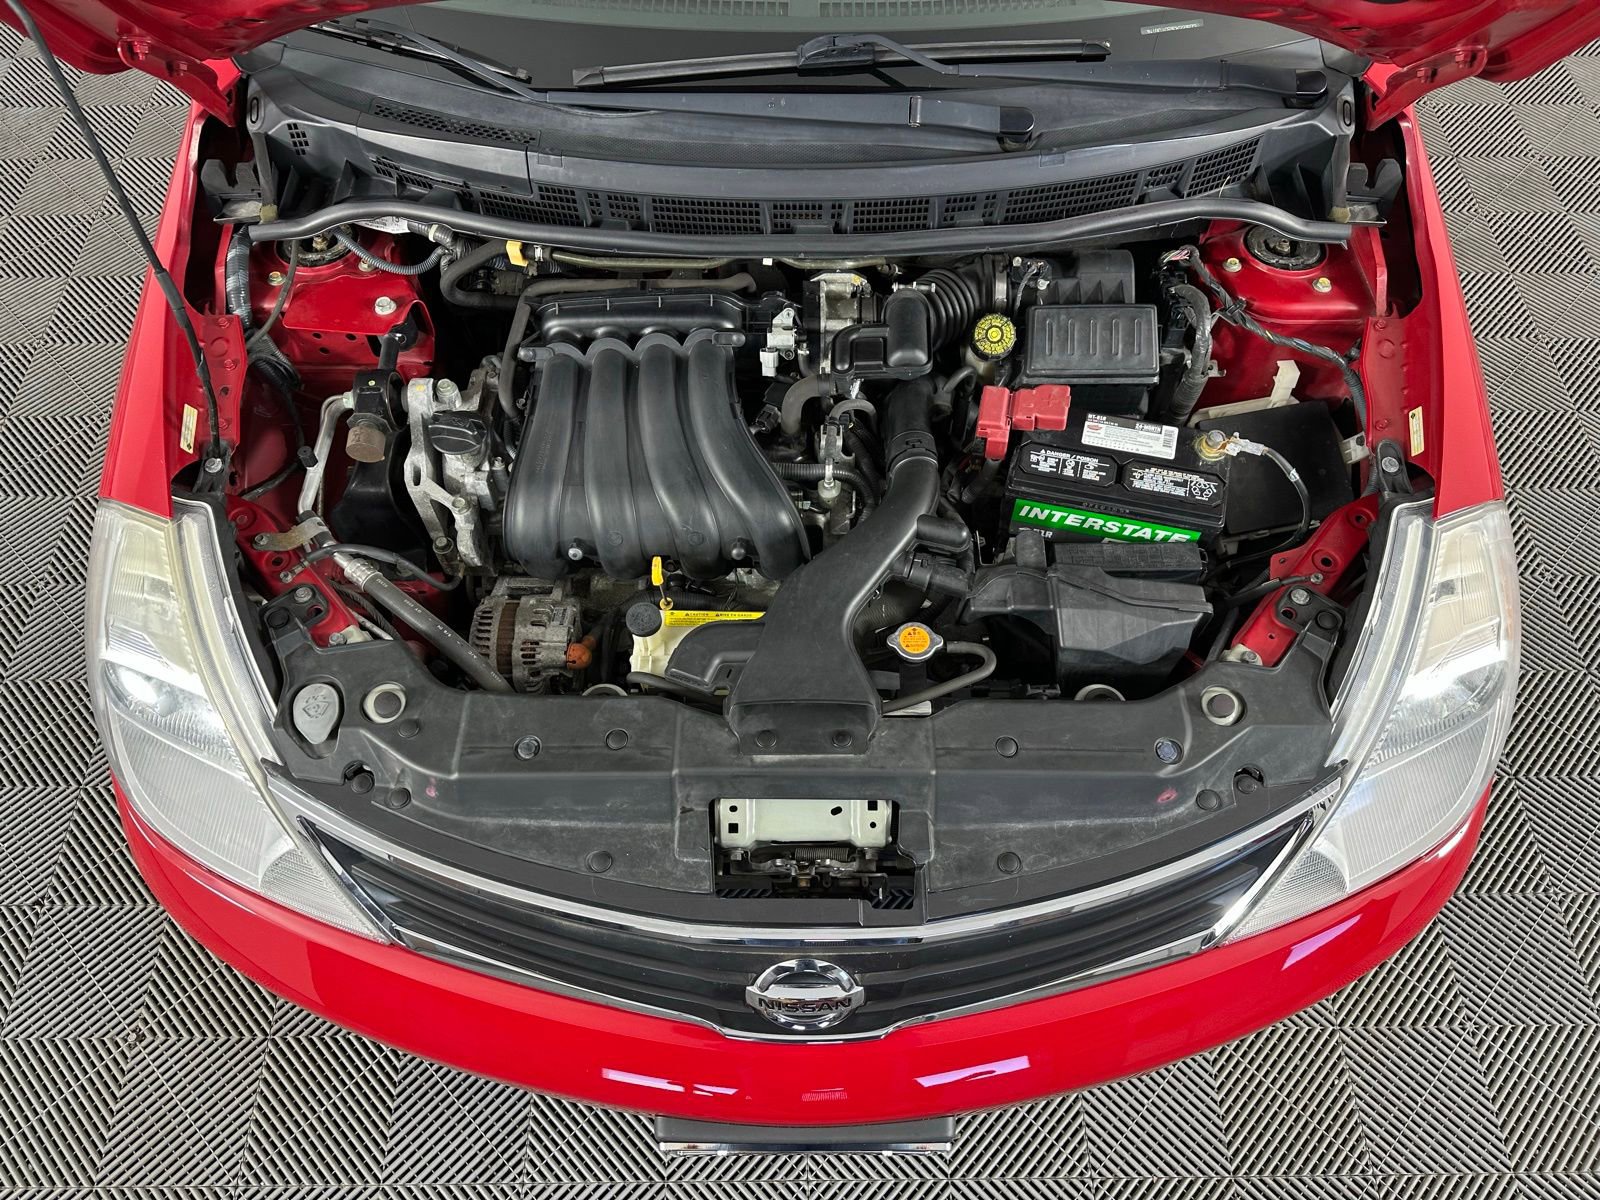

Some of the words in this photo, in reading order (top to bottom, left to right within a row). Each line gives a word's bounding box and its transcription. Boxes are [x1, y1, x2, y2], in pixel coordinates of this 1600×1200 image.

[1046, 450, 1071, 459] DANGER
[1076, 455, 1099, 463] POISON
[1018, 505, 1192, 543] INTERSTATE
[757, 997, 852, 1013] NISSAN
